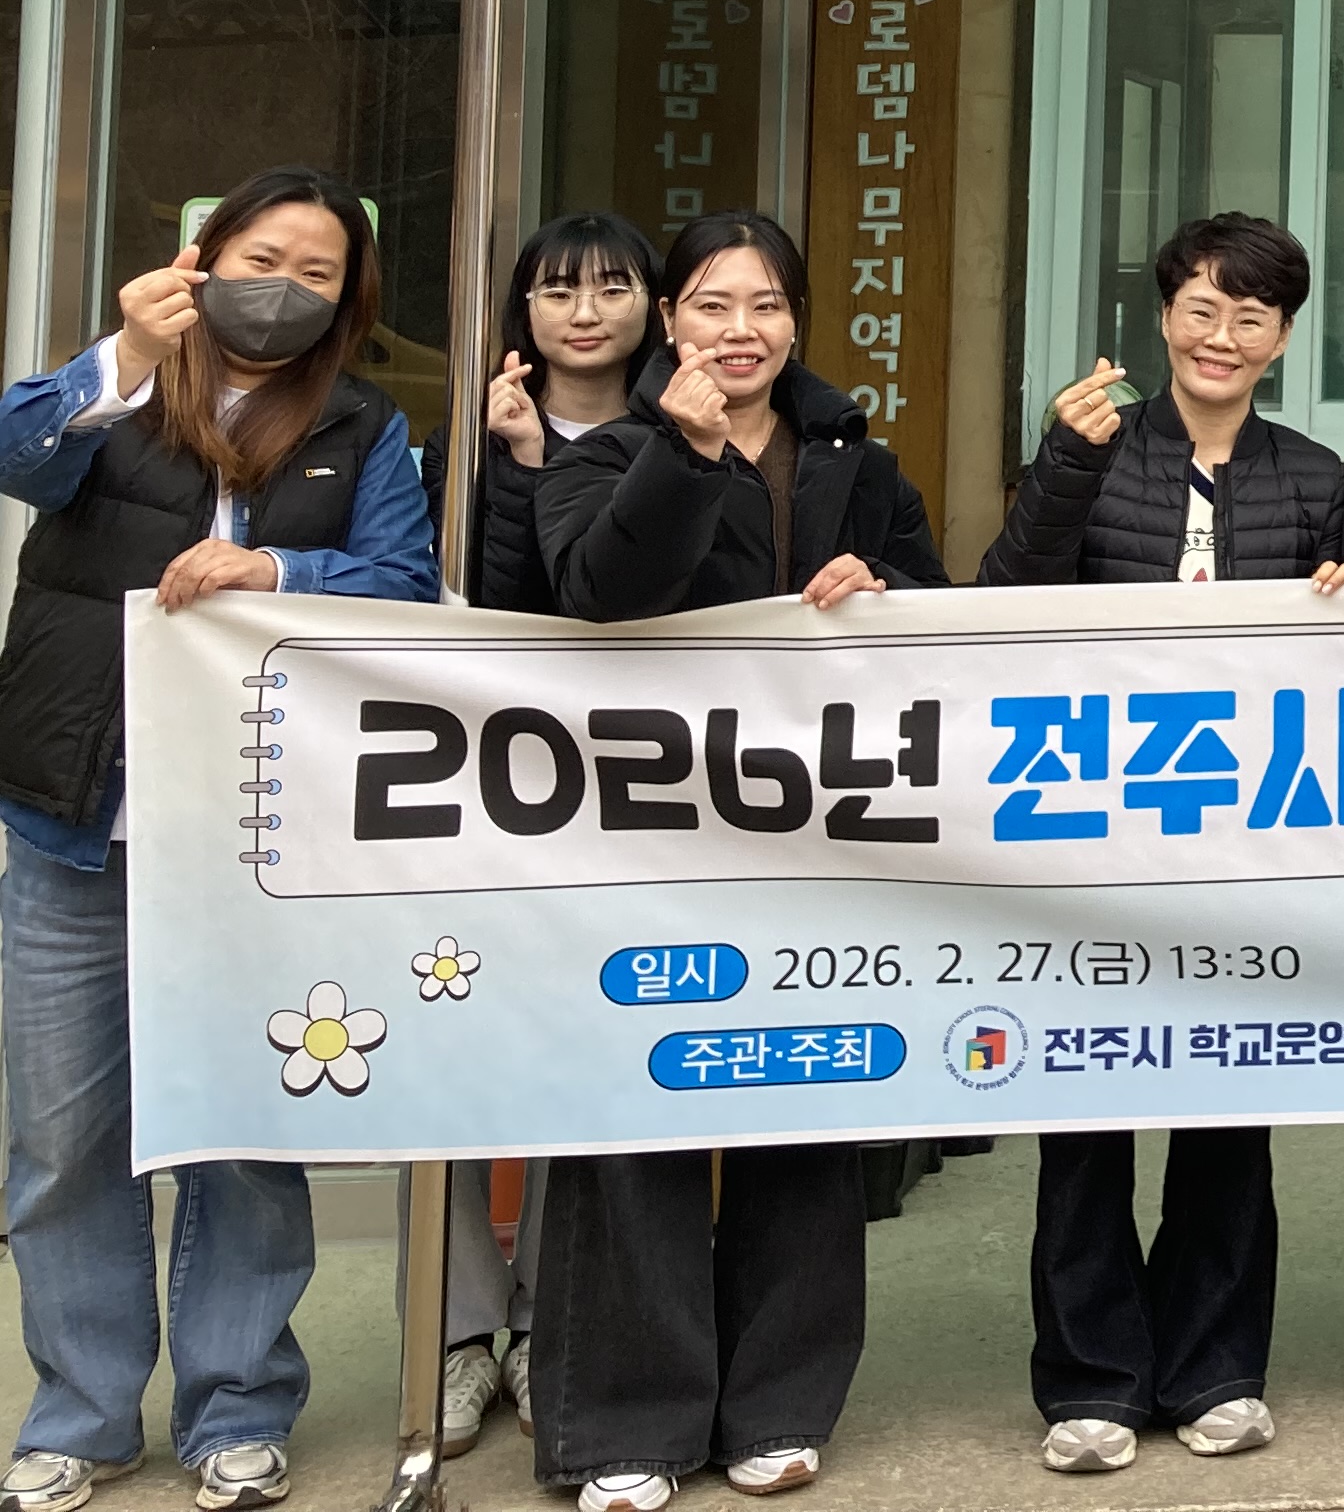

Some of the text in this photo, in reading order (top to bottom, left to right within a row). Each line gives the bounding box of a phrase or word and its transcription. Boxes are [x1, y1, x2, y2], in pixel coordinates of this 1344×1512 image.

[849, 0, 916, 447] 로뎀나무지역아
[354, 700, 942, 843] 2026년
[632, 938, 1302, 997] 일시 2026. 2. 27.(금) 13:30
[680, 1027, 876, 1082] 주관·주최
[1044, 1025, 1174, 1073] 전주시
